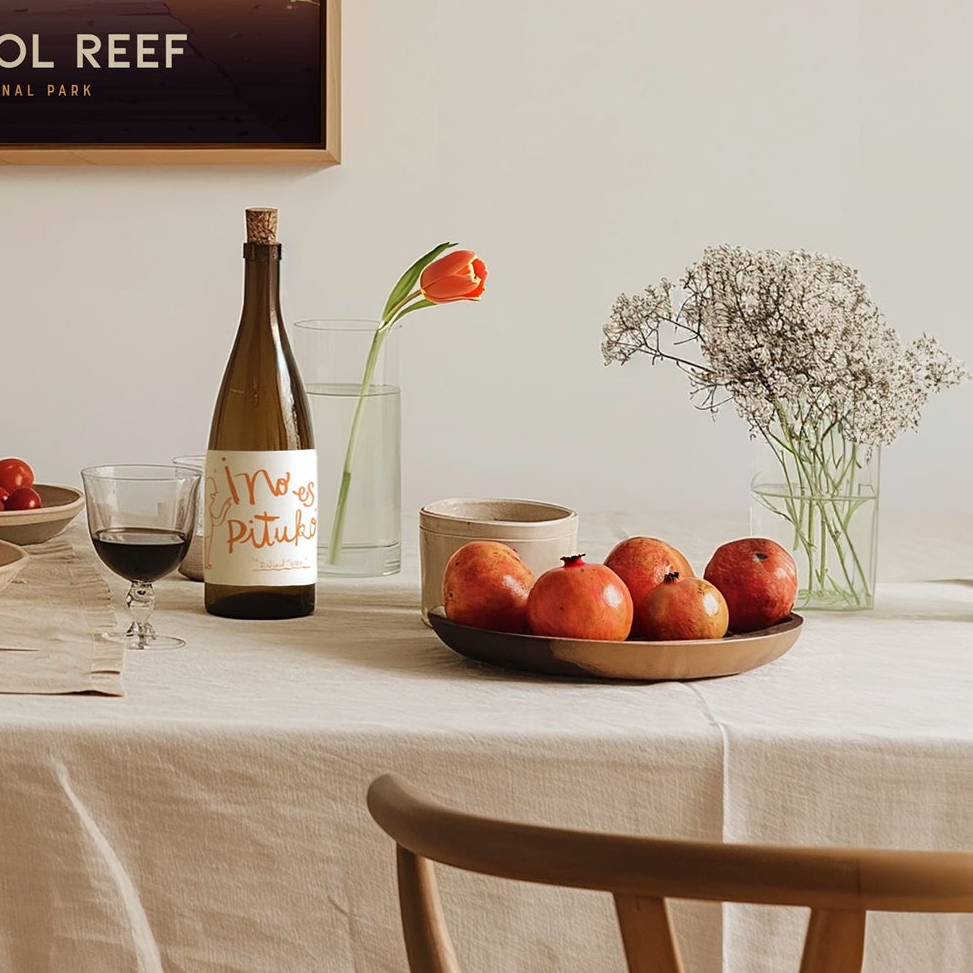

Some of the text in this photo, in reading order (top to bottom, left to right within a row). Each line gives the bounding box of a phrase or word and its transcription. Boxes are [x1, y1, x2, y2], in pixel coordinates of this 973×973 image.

[77, 33, 188, 69] REEF
[47, 84, 92, 97] PARK
[292, 481, 315, 507] es
